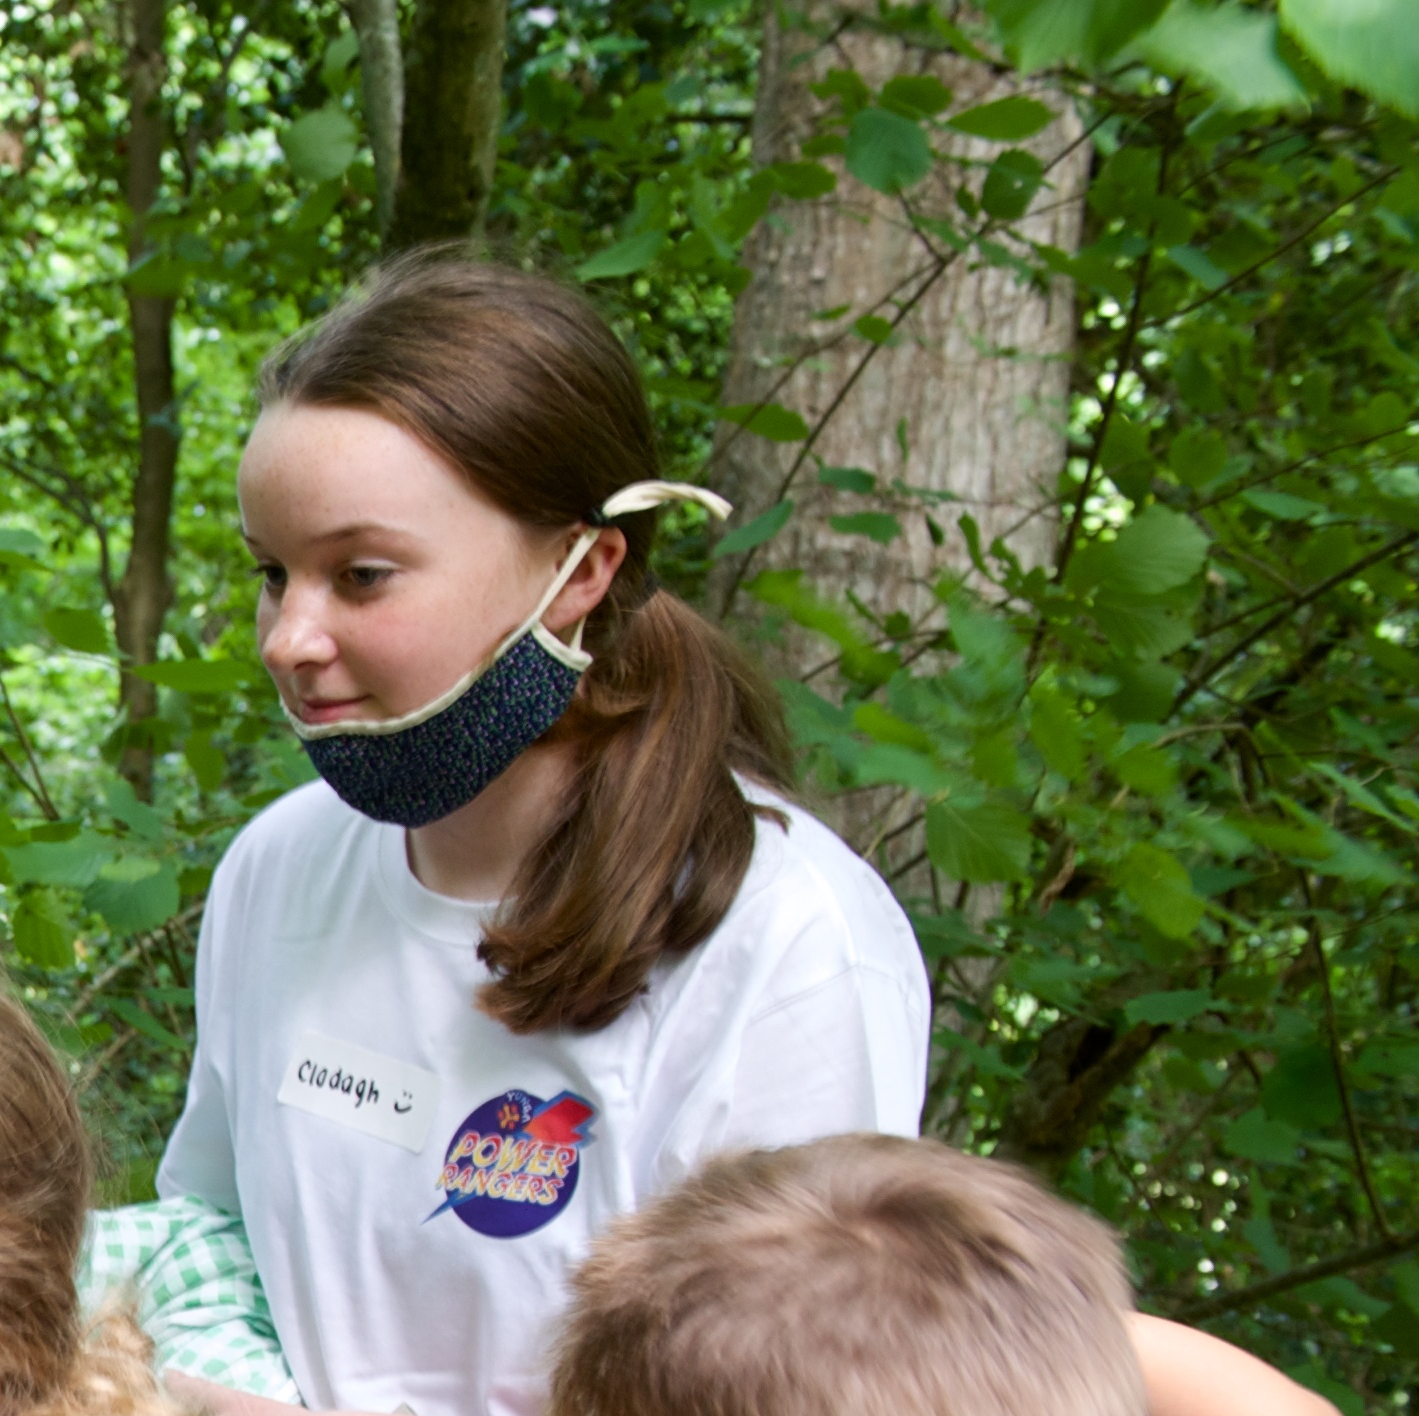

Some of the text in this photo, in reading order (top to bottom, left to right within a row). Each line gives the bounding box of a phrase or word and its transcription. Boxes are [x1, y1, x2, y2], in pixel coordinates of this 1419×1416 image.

[298, 1059, 380, 1109] Clodagh
[448, 1131, 577, 1178] POWER
[435, 1162, 565, 1206] RANGERS
